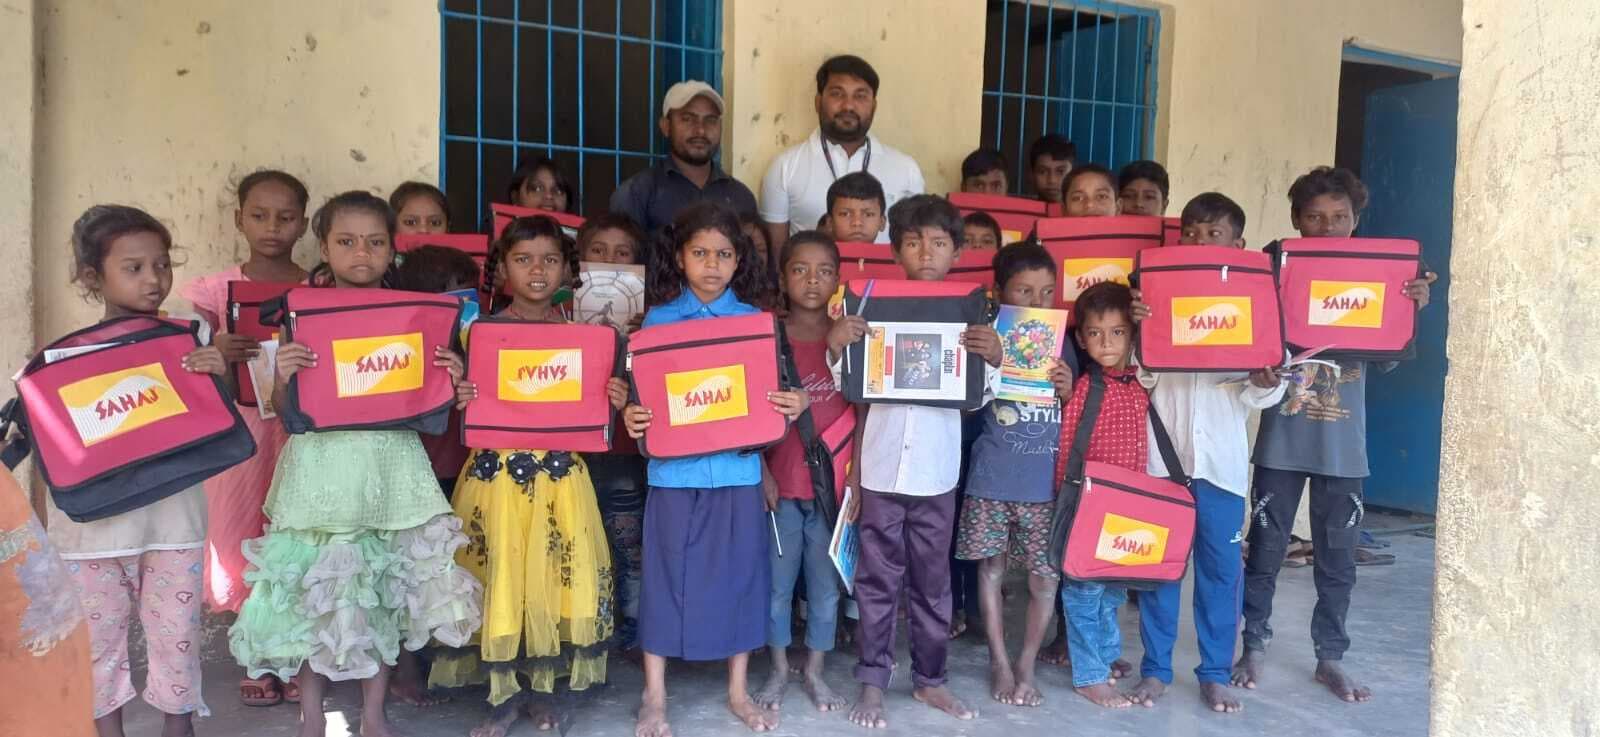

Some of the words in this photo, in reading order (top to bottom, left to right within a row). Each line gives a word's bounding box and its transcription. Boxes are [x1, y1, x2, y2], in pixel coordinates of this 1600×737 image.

[1322, 295, 1369, 310] SAHAJ
[1188, 314, 1238, 331] SAHAJ
[355, 354, 411, 373] SAHAJ
[518, 365, 568, 380] SAHAJ
[95, 388, 160, 420] SAHAJ
[685, 389, 733, 407] SAHAJ
[1112, 536, 1154, 555] SAHAJ
